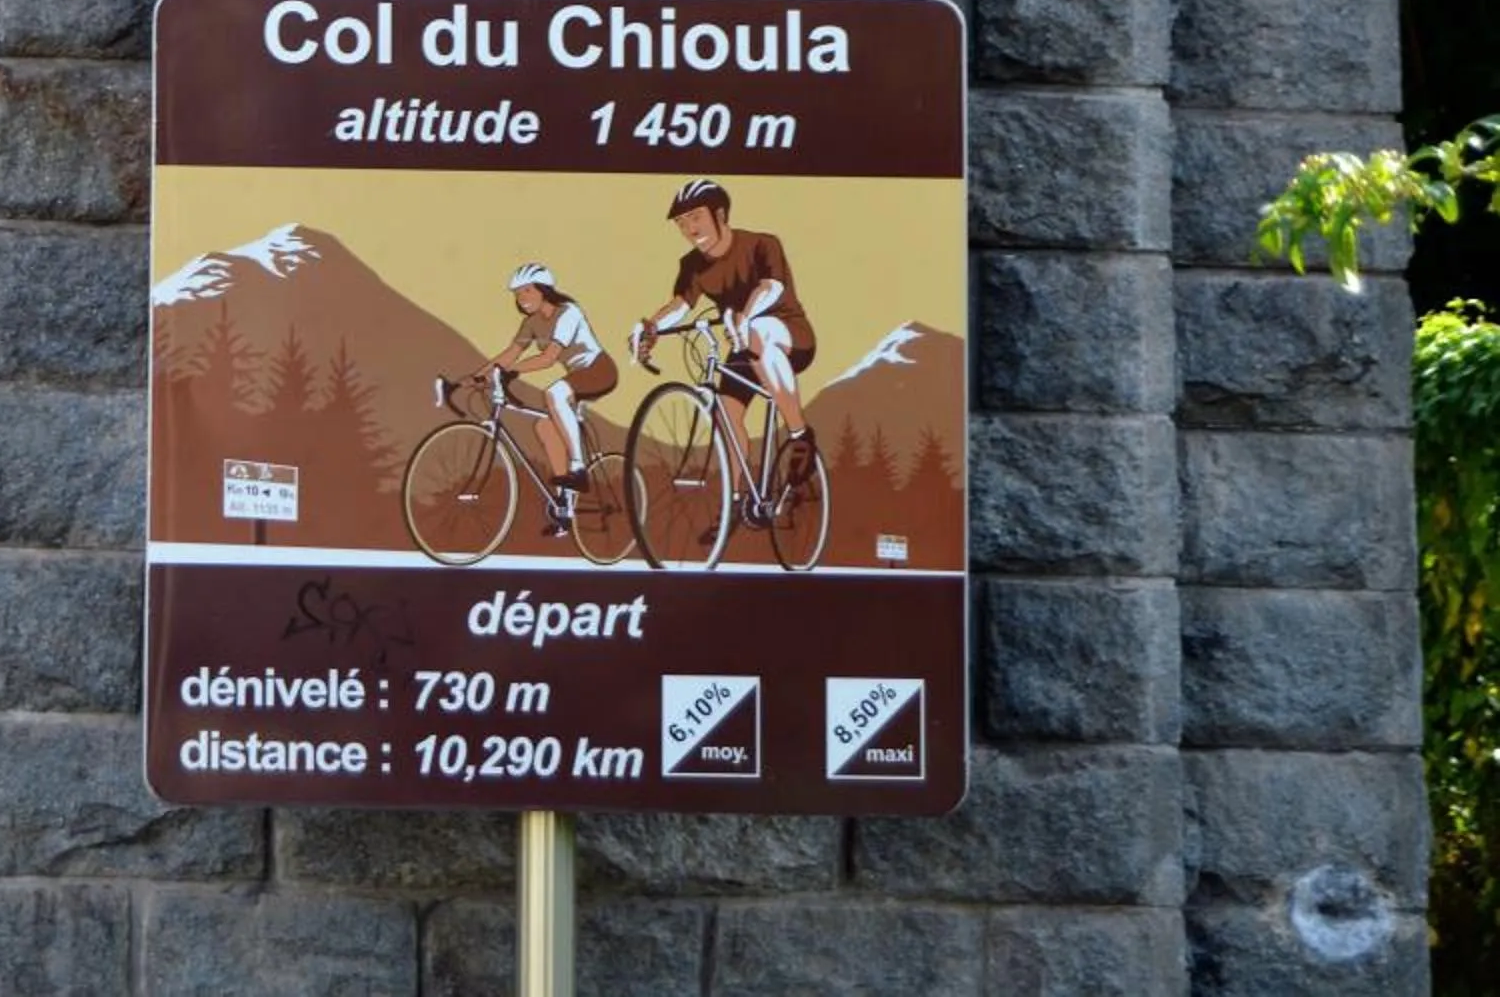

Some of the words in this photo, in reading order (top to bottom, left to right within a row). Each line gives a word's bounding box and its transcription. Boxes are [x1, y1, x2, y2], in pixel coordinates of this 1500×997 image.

[264, 0, 393, 65] Col
[422, 3, 518, 68] du
[548, 4, 850, 73] Chioula
[334, 97, 540, 144] altitude
[745, 114, 796, 148] m
[467, 590, 647, 648] départ
[180, 666, 365, 709] dénivelé
[415, 671, 495, 712] 730
[505, 682, 550, 712] m
[668, 682, 731, 742] 6,10%
[833, 683, 897, 744] 8,50%
[179, 730, 368, 773] distance
[415, 734, 561, 782] 10,290
[572, 737, 644, 778] km
[701, 746, 749, 764] moy.
[865, 744, 913, 762] maxi
